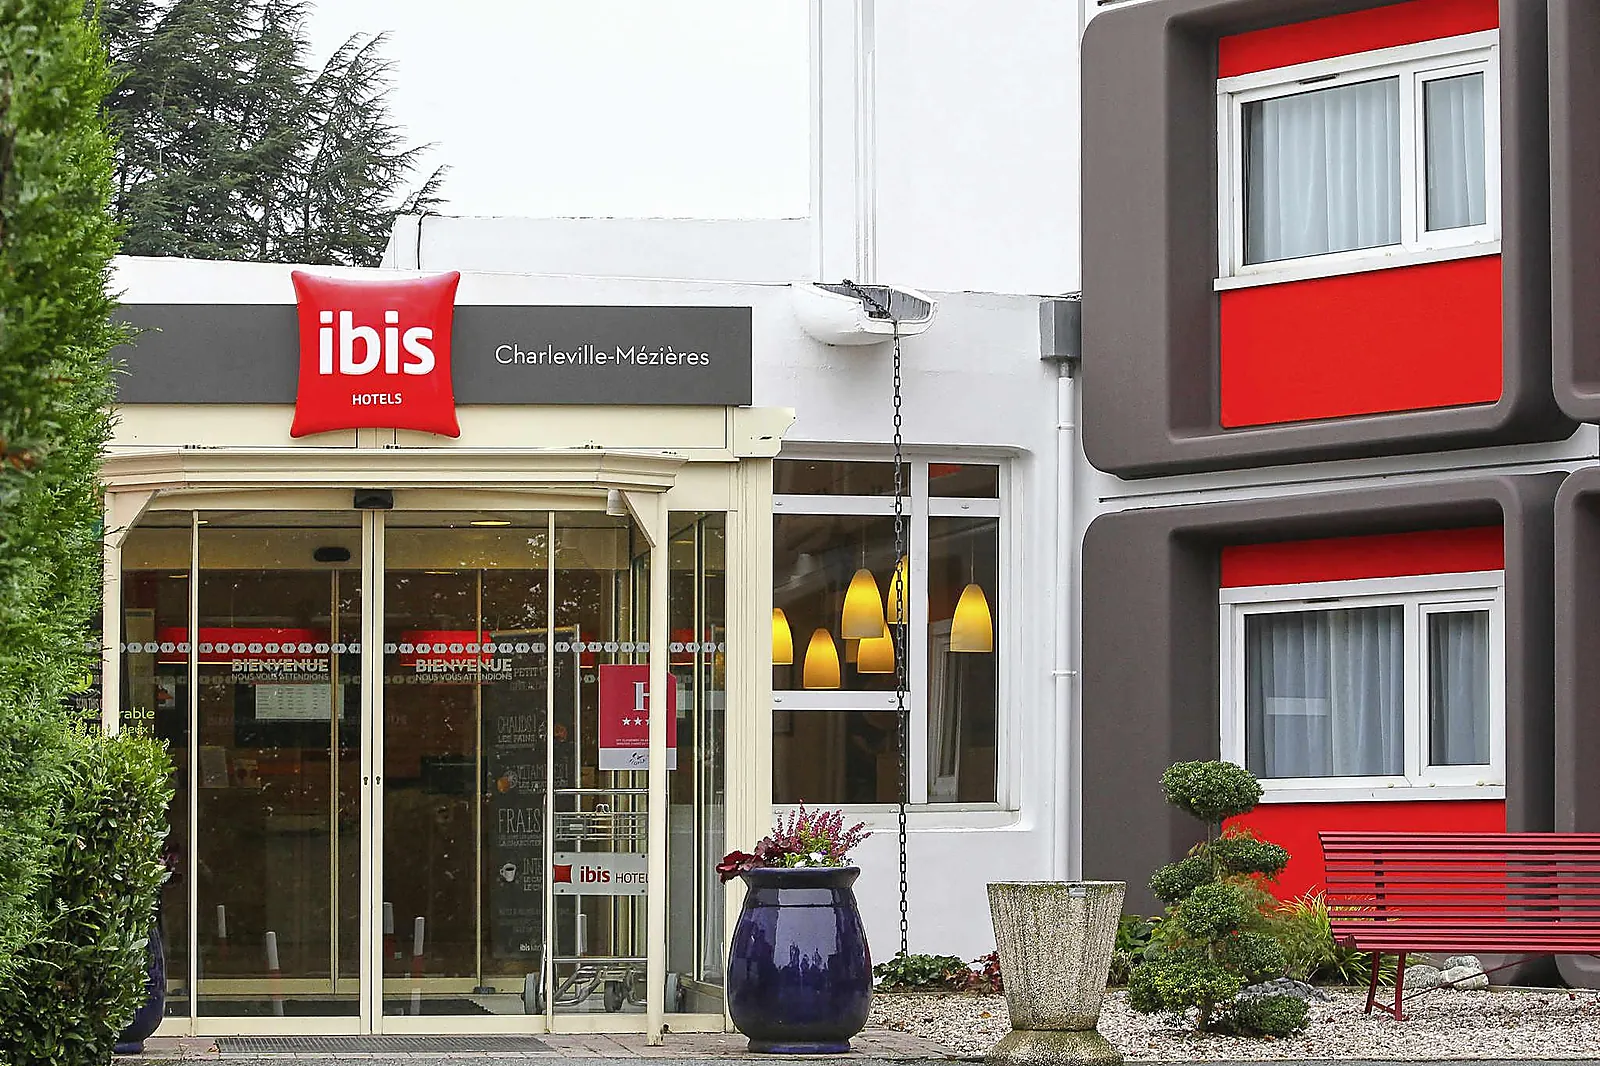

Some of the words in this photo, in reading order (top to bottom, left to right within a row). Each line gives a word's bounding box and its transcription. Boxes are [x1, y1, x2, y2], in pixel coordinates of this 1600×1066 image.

[319, 310, 436, 375] ibis
[494, 344, 710, 366] Charleville-Mézières
[352, 393, 402, 405] HOTELS
[232, 659, 329, 672] BIENVENUE
[416, 659, 513, 672] BIENVENUE
[232, 673, 255, 681] NOUS
[256, 673, 277, 681] VOUS
[278, 673, 329, 681] ATTENDIONS
[416, 673, 438, 681] NOUS
[440, 673, 461, 681] VOUS
[463, 672, 513, 681] ATTENDIONS
[498, 808, 541, 834] FRAIS
[580, 865, 611, 883] ibis
